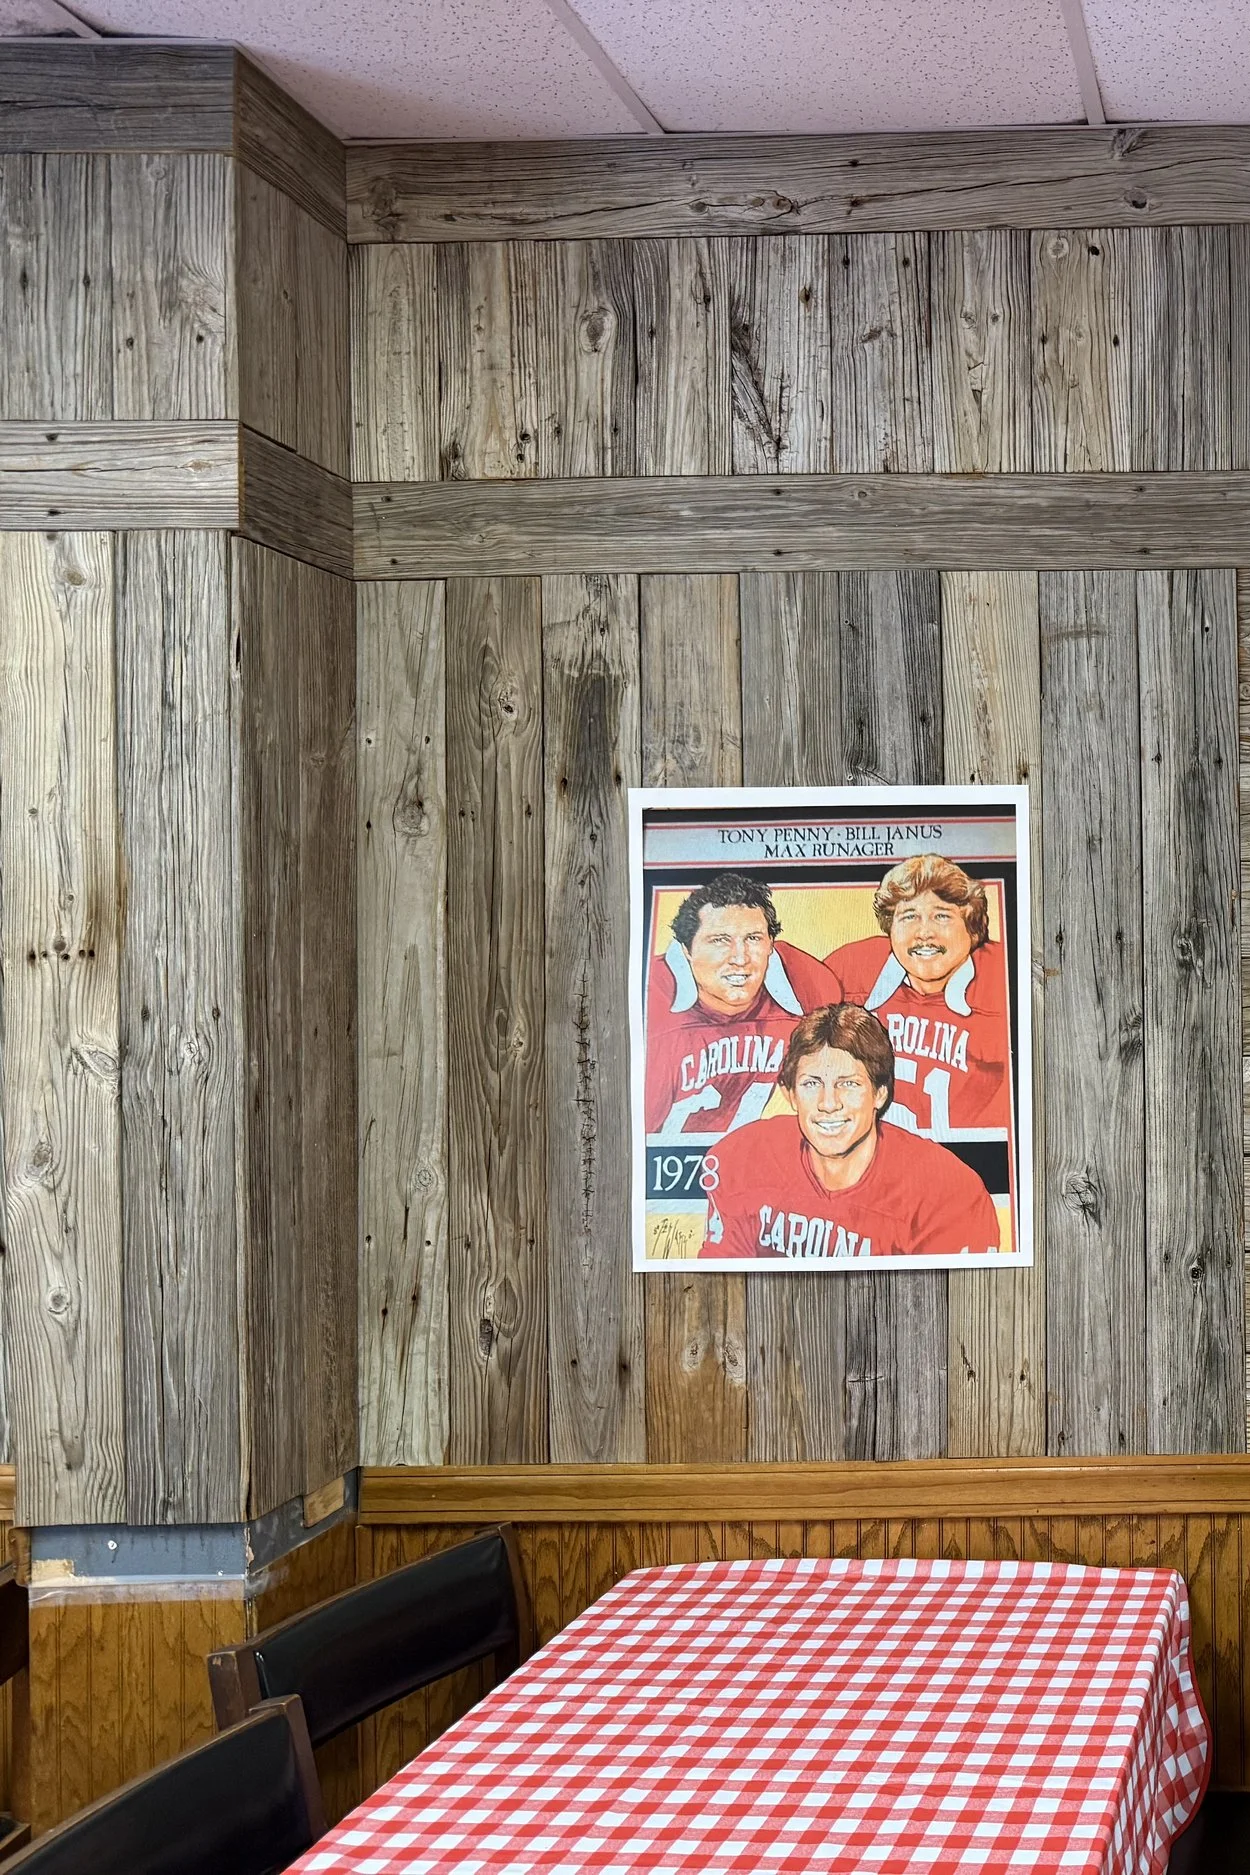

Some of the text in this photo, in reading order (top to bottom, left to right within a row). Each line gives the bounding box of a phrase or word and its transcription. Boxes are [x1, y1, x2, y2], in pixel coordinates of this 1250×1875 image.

[718, 825, 943, 844] TONY PENNY BILL JANUS
[764, 842, 895, 859] MAX RUNAGER
[885, 1012, 970, 1073] ROLINA
[681, 1035, 785, 1092] CAROLINA
[653, 1155, 720, 1191] 1978
